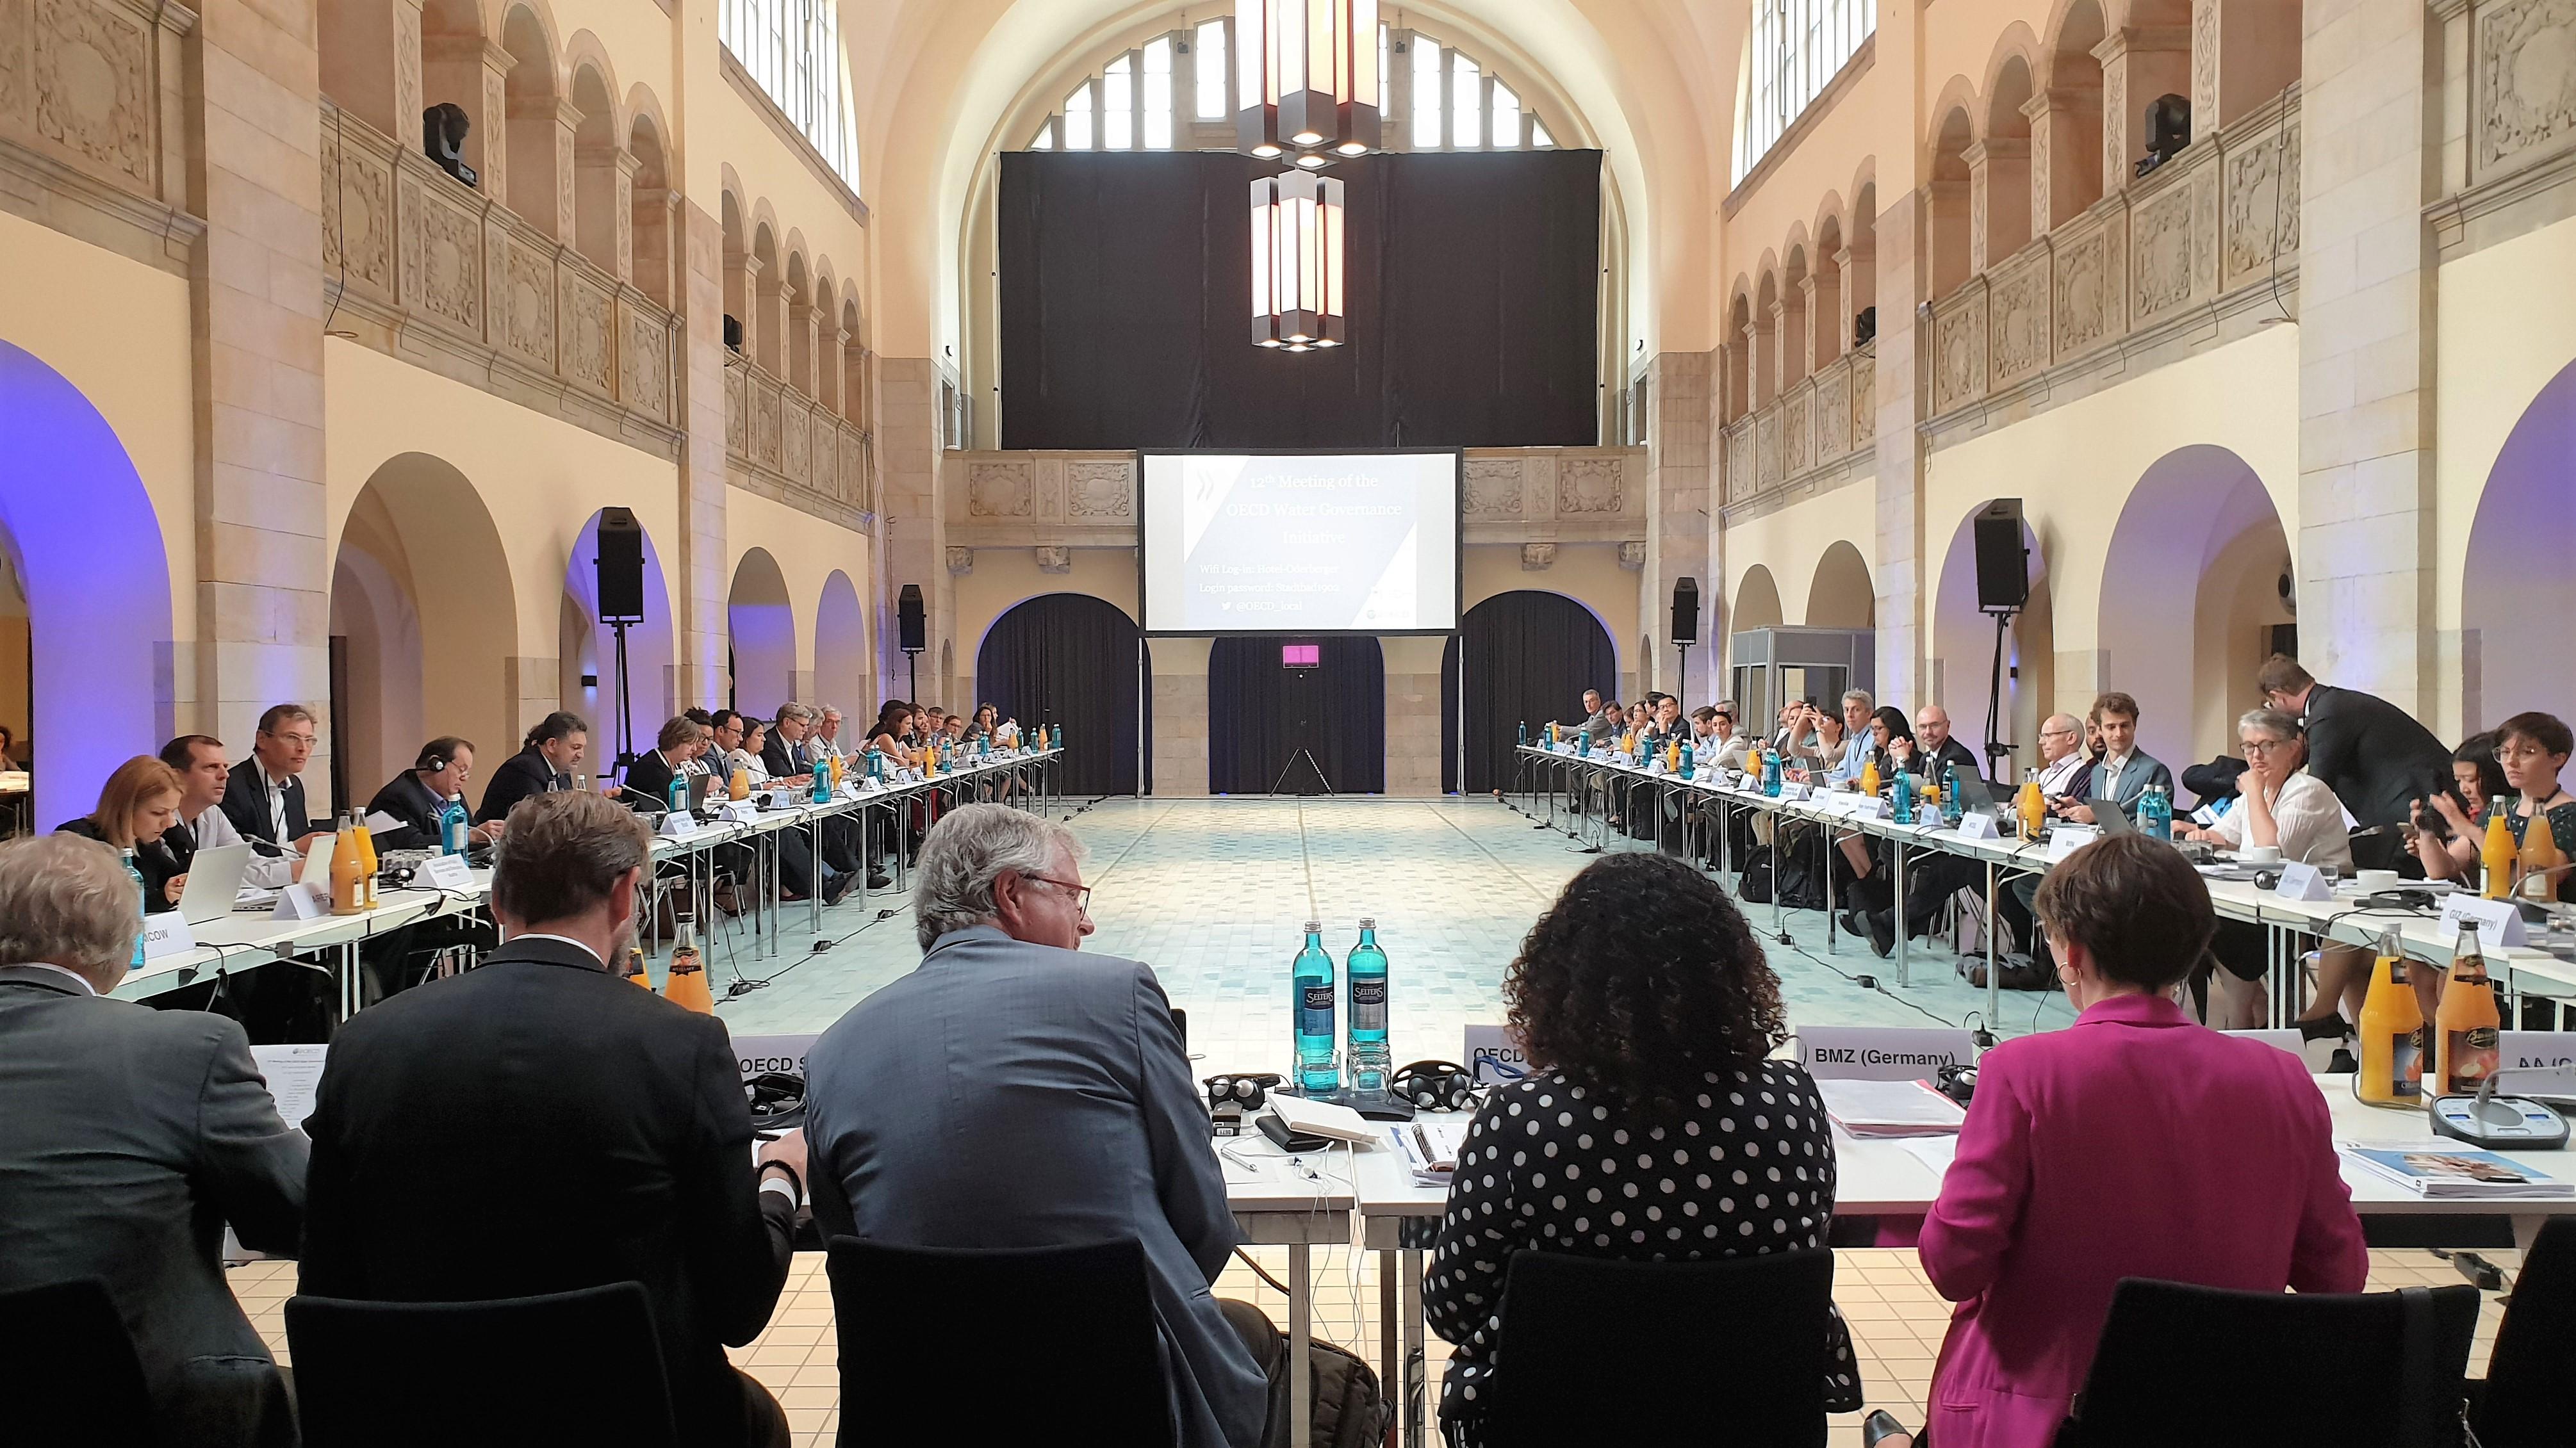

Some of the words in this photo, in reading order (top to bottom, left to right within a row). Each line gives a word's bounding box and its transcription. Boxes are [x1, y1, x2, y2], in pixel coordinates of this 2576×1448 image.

[1250, 475, 1276, 488] 12th
[1279, 475, 1335, 490] Meeting
[1338, 474, 1354, 487] of
[1356, 474, 1379, 487] the
[1226, 503, 1270, 516] OECD
[1274, 504, 1315, 516] Water
[1319, 503, 1402, 516] Governance
[1283, 530, 1345, 544] Initiative
[1199, 564, 1220, 574] Wifi
[1222, 564, 1255, 575] Log-in:
[1199, 583, 1226, 594] Login
[1227, 583, 1274, 594] password:
[1235, 601, 1302, 612] @OECD_local
[1815, 1048, 1856, 1063] BMZ
[1860, 1048, 1956, 1068] (Germany)
[739, 1057, 793, 1073] OECD
